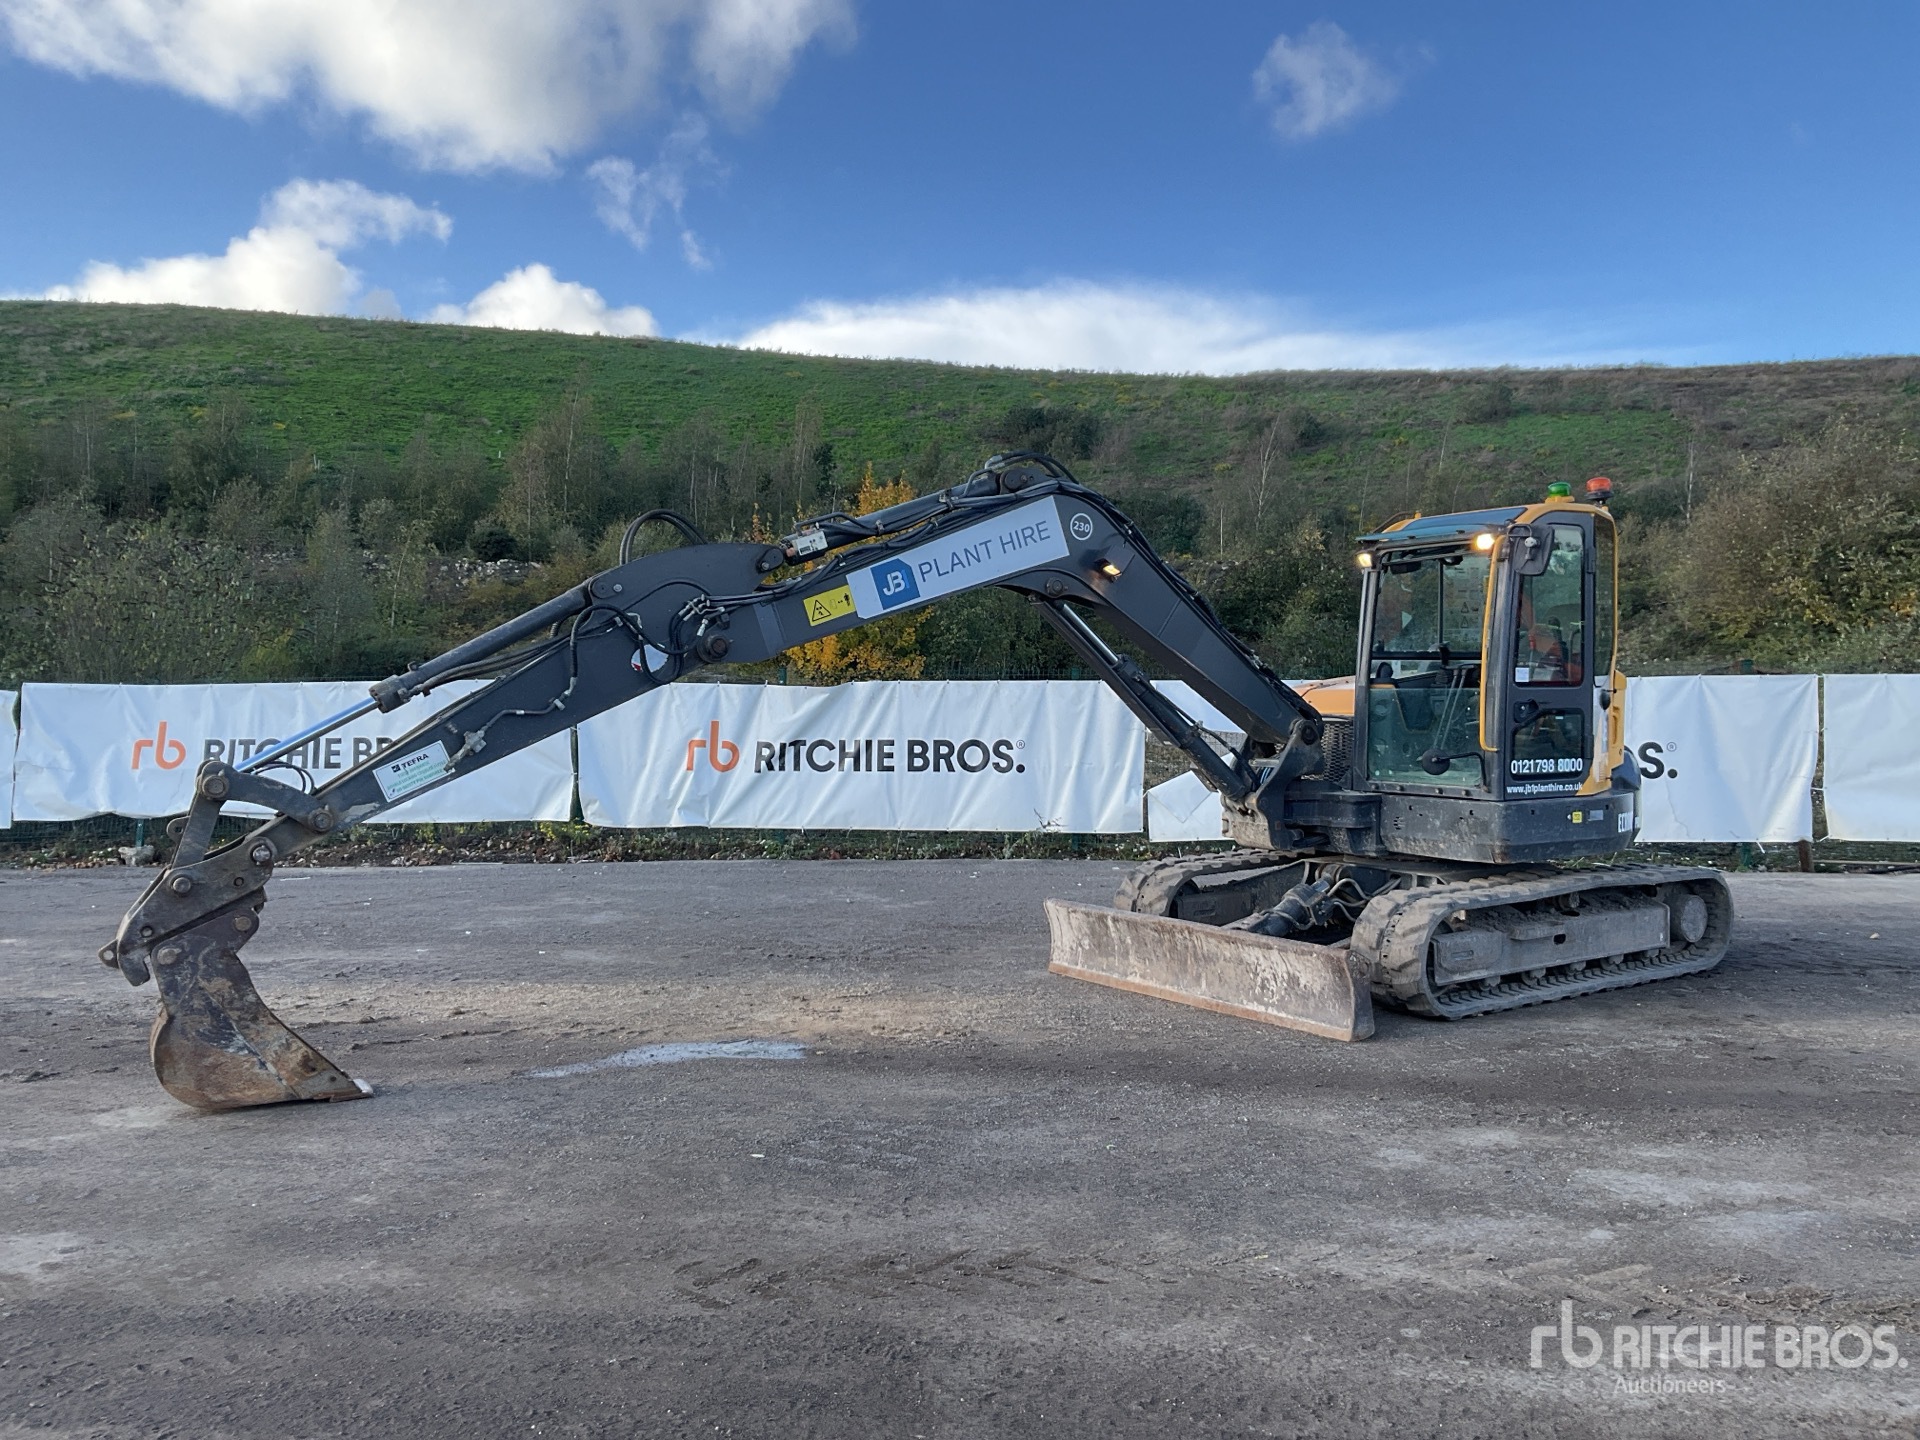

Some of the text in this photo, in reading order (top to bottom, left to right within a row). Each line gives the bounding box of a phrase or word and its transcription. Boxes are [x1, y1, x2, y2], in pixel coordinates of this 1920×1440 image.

[1073, 520, 1090, 533] 230
[917, 539, 992, 583] PLANT
[999, 520, 1051, 555] HIRE
[132, 721, 187, 770] rb
[401, 753, 429, 769] TEFRA
[686, 720, 740, 772] rb
[754, 738, 895, 774] RITCHIE
[1557, 757, 1583, 772] 8000
